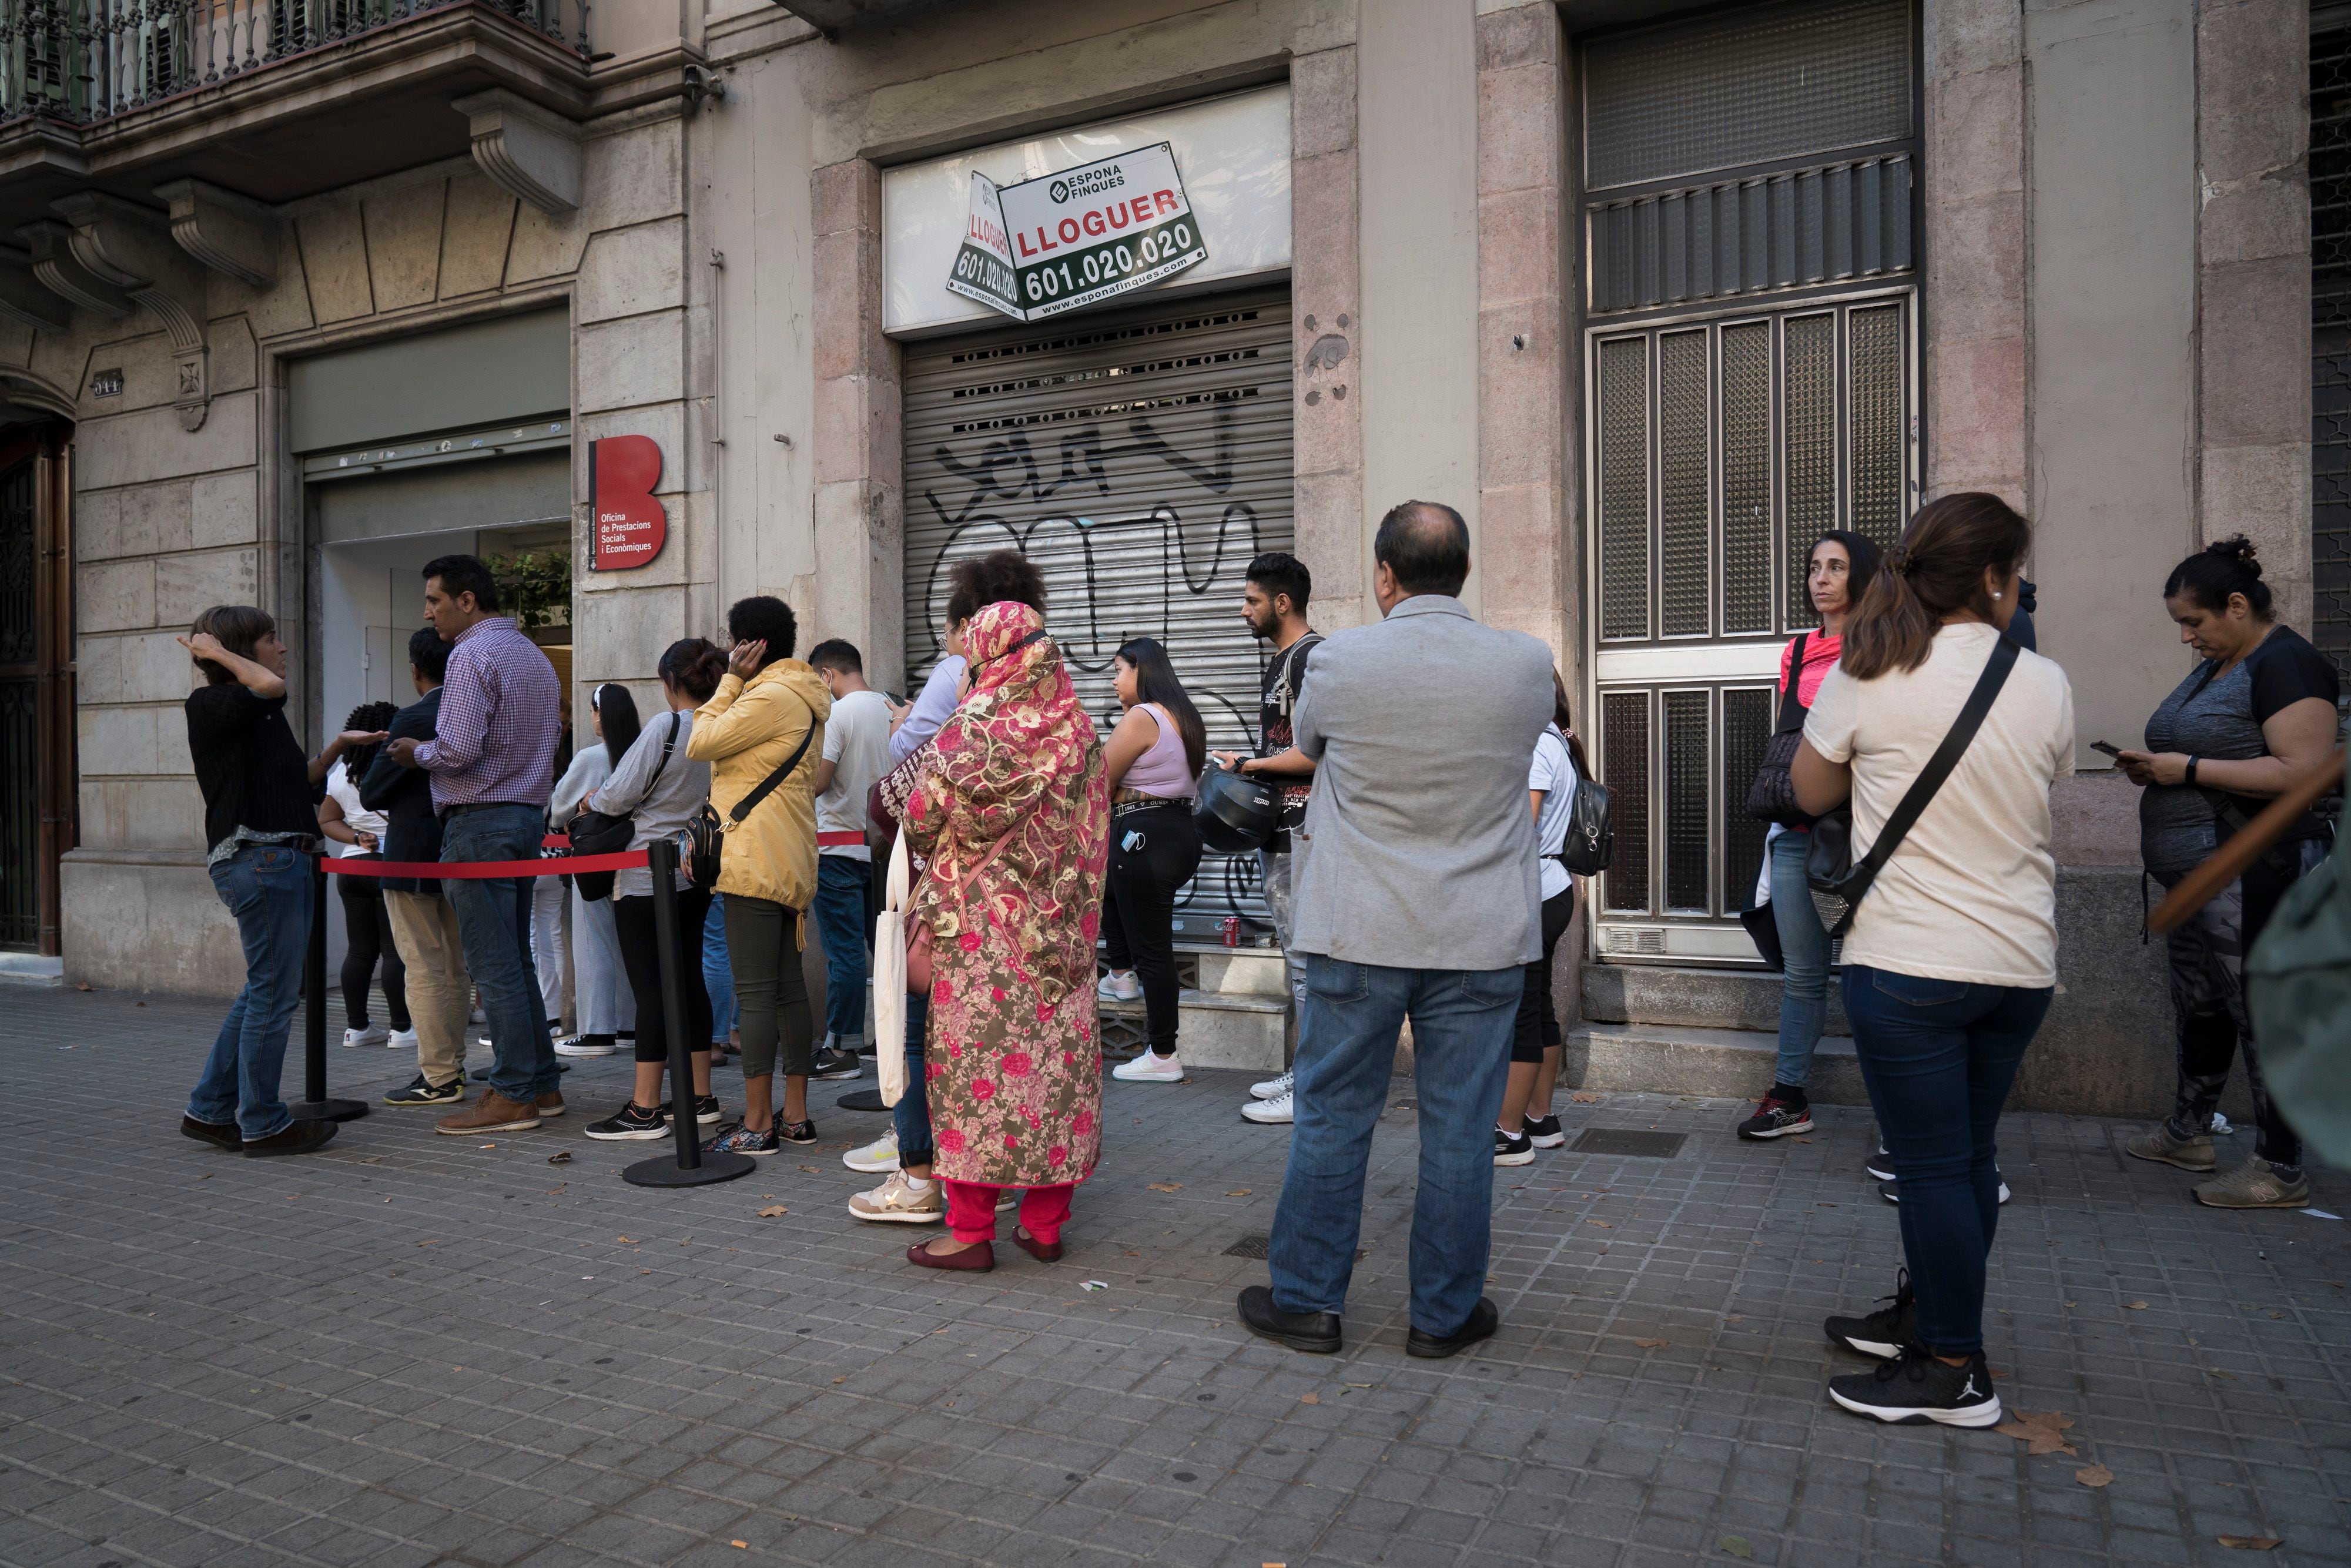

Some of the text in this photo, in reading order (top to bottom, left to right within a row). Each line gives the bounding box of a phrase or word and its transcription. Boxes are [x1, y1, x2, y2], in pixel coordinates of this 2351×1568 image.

[1068, 165, 1121, 187] ESPONA
[1071, 176, 1125, 199] FINQUES
[1017, 189, 1179, 257] LLOGUER
[970, 214, 1010, 259] LLOGUER
[1026, 223, 1191, 301] 601.020.020
[957, 250, 1017, 303] 601.020.020
[1041, 257, 1188, 314] www.esponafinques.com
[957, 283, 1017, 316] www.esponafinques.com
[601, 512, 626, 522] Oficina
[601, 521, 651, 533] de Prestacions
[601, 533, 626, 544] Socials
[601, 542, 652, 554] i Econòmiques
[2247, 1181, 2280, 1202] N
